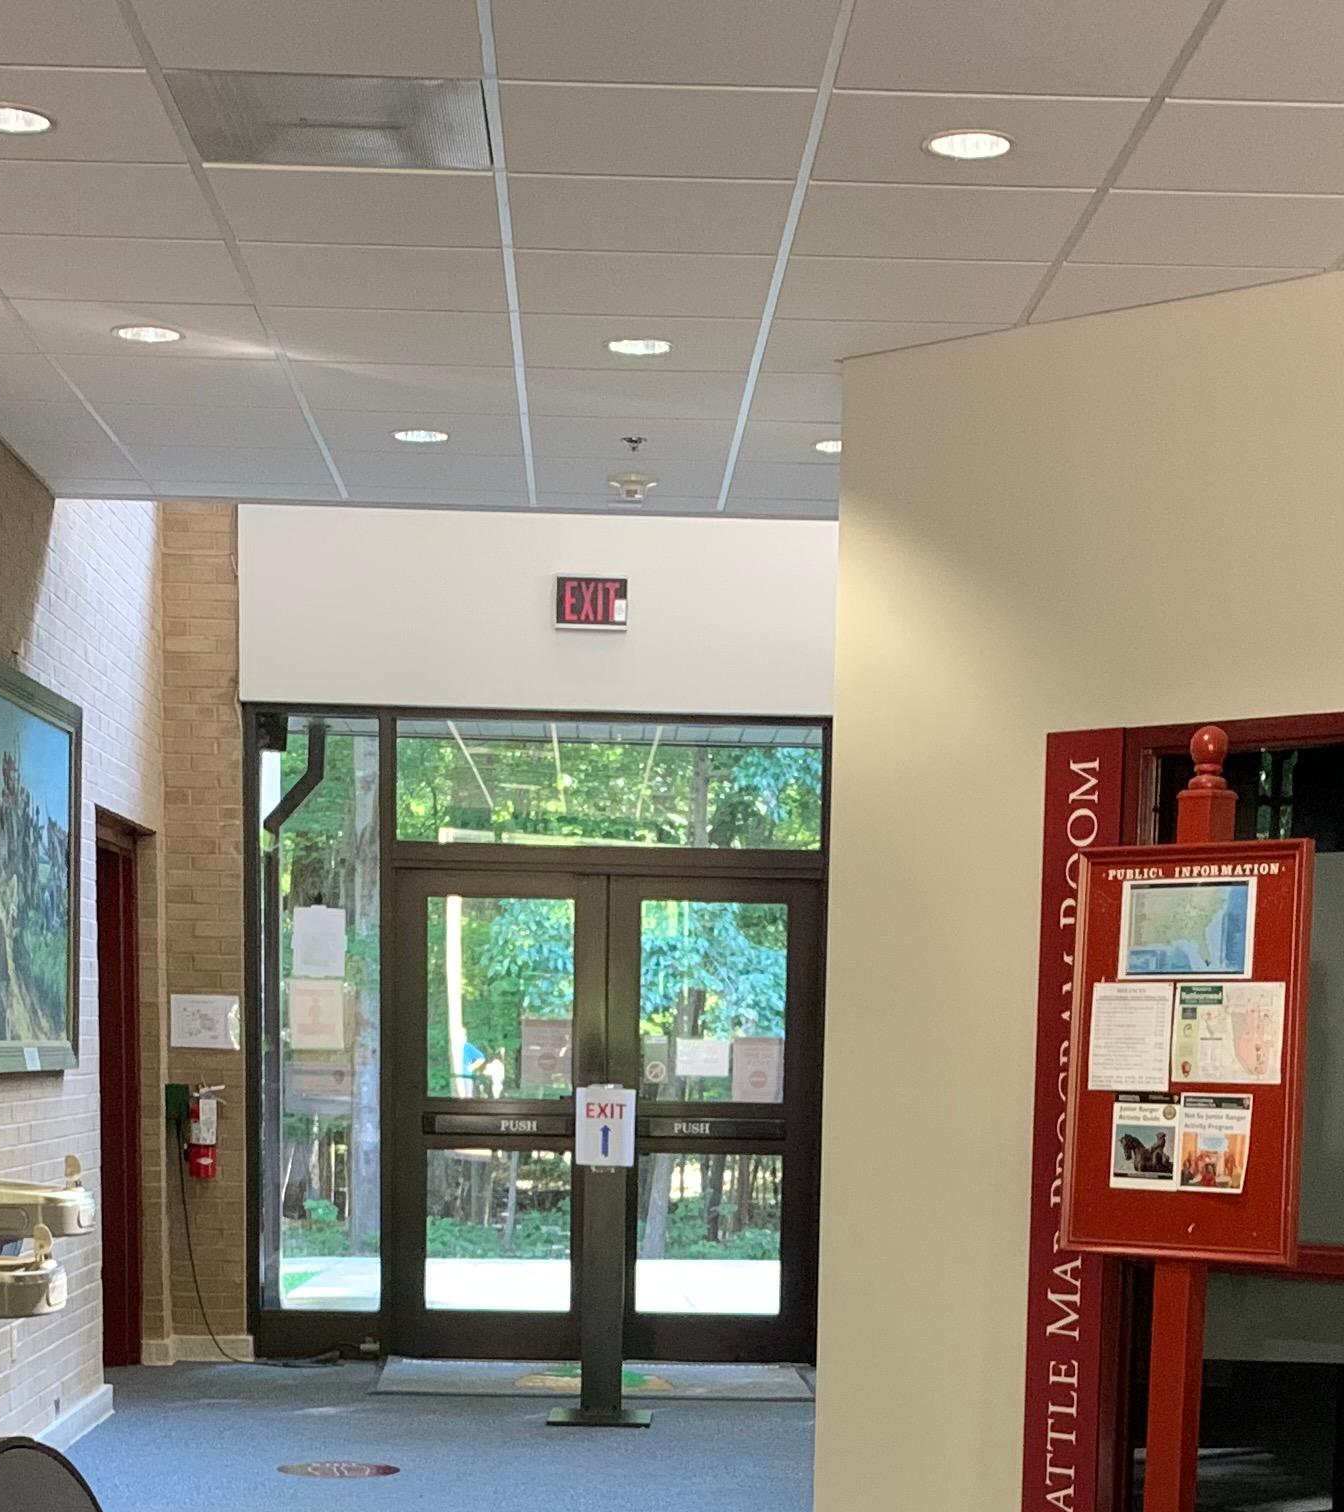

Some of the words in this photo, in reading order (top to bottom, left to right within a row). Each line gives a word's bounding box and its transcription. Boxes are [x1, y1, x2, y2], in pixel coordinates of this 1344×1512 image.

[564, 581, 620, 624] EXIT
[1174, 863, 1280, 878] INFORMATION
[585, 1103, 627, 1120] EXIT
[500, 1120, 538, 1133] PUSH
[673, 1122, 711, 1134] PUSH
[1045, 1229, 1083, 1342] MA
